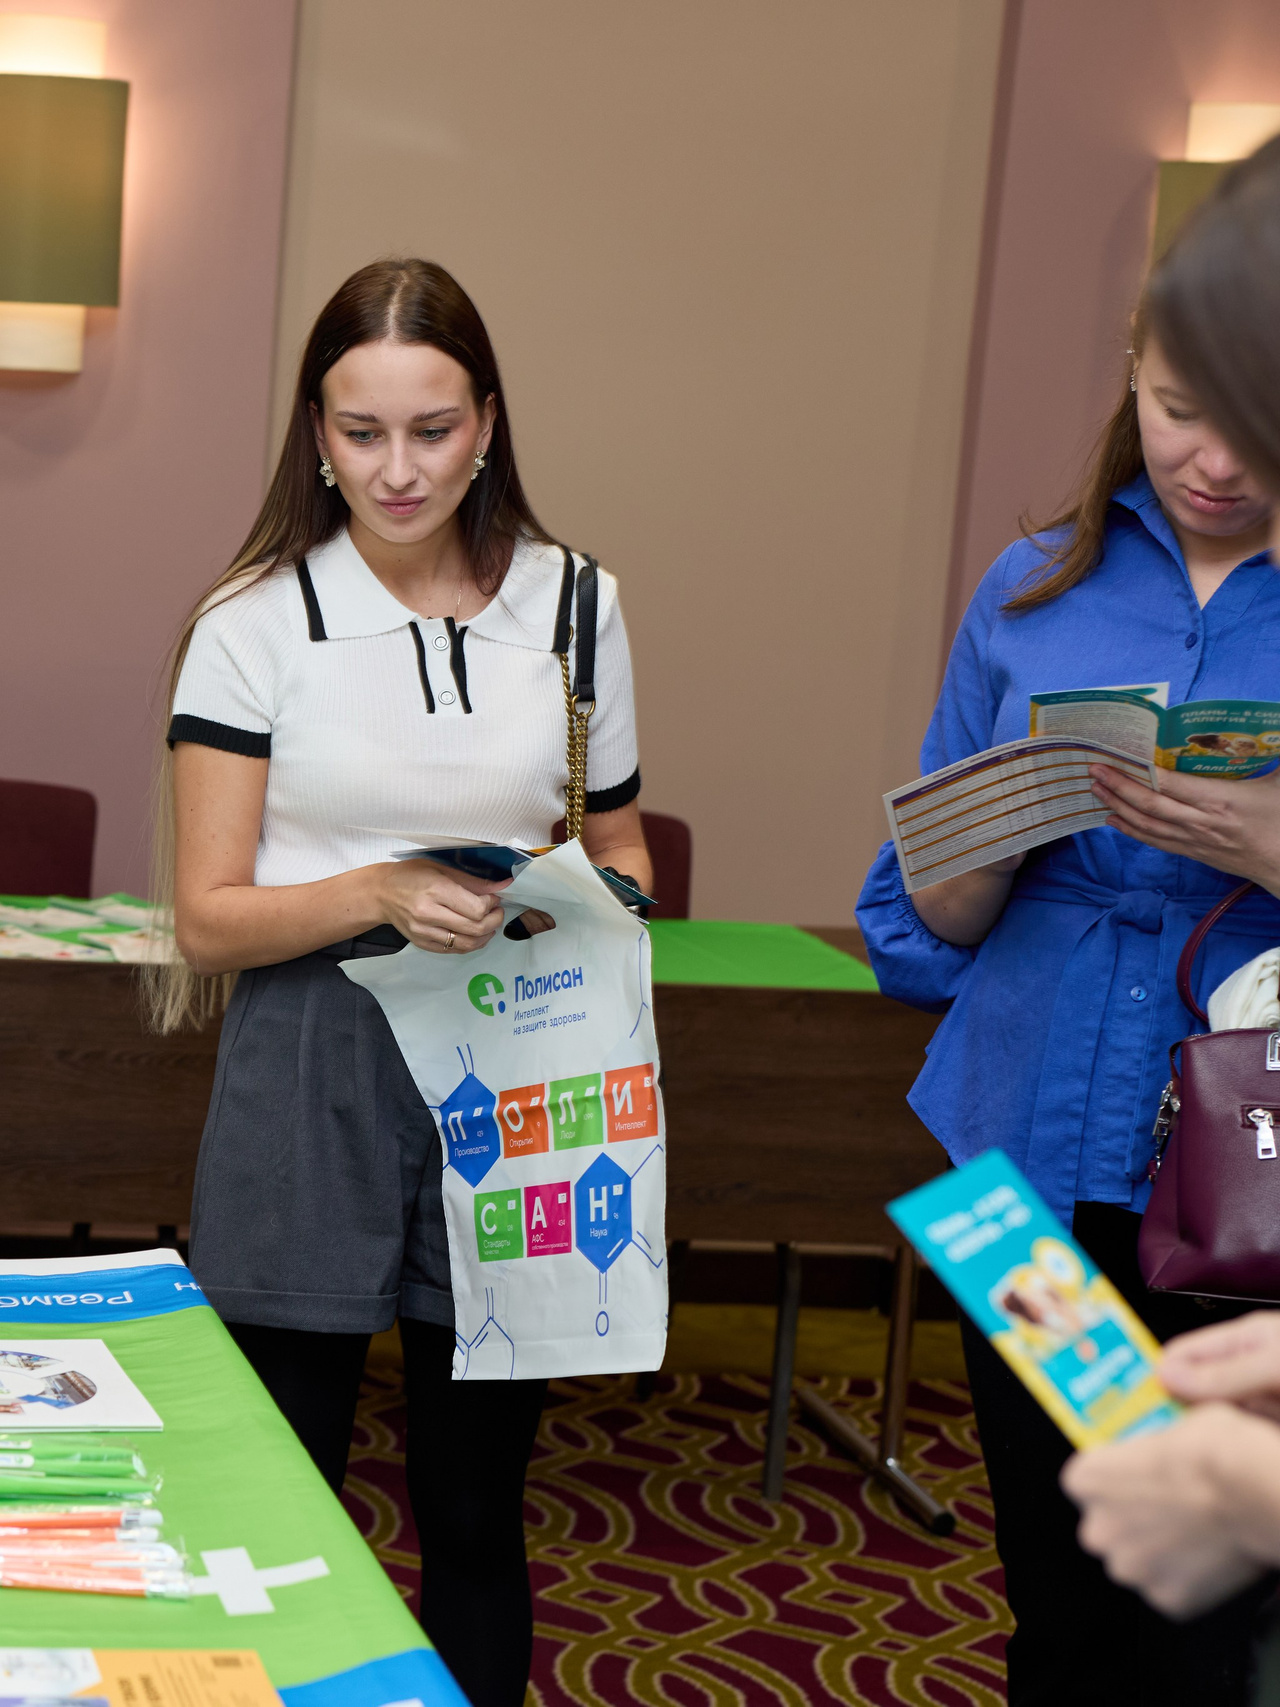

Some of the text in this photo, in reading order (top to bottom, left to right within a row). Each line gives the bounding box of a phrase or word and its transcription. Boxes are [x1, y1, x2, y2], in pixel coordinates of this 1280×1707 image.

[515, 966, 584, 1003] Полисан
[514, 1004, 550, 1022] Интеллект
[513, 1011, 587, 1036] на защите здоровья
[611, 1080, 634, 1116] И
[558, 1091, 576, 1125] Л
[448, 1110, 467, 1142] П
[614, 1120, 647, 1131] Интеллект
[509, 1137, 534, 1149] Открытия
[560, 1130, 576, 1140] Люди
[454, 1145, 490, 1158] Производство
[589, 1186, 608, 1222] Н
[531, 1233, 545, 1243] АФС
[589, 1227, 608, 1240] Наука
